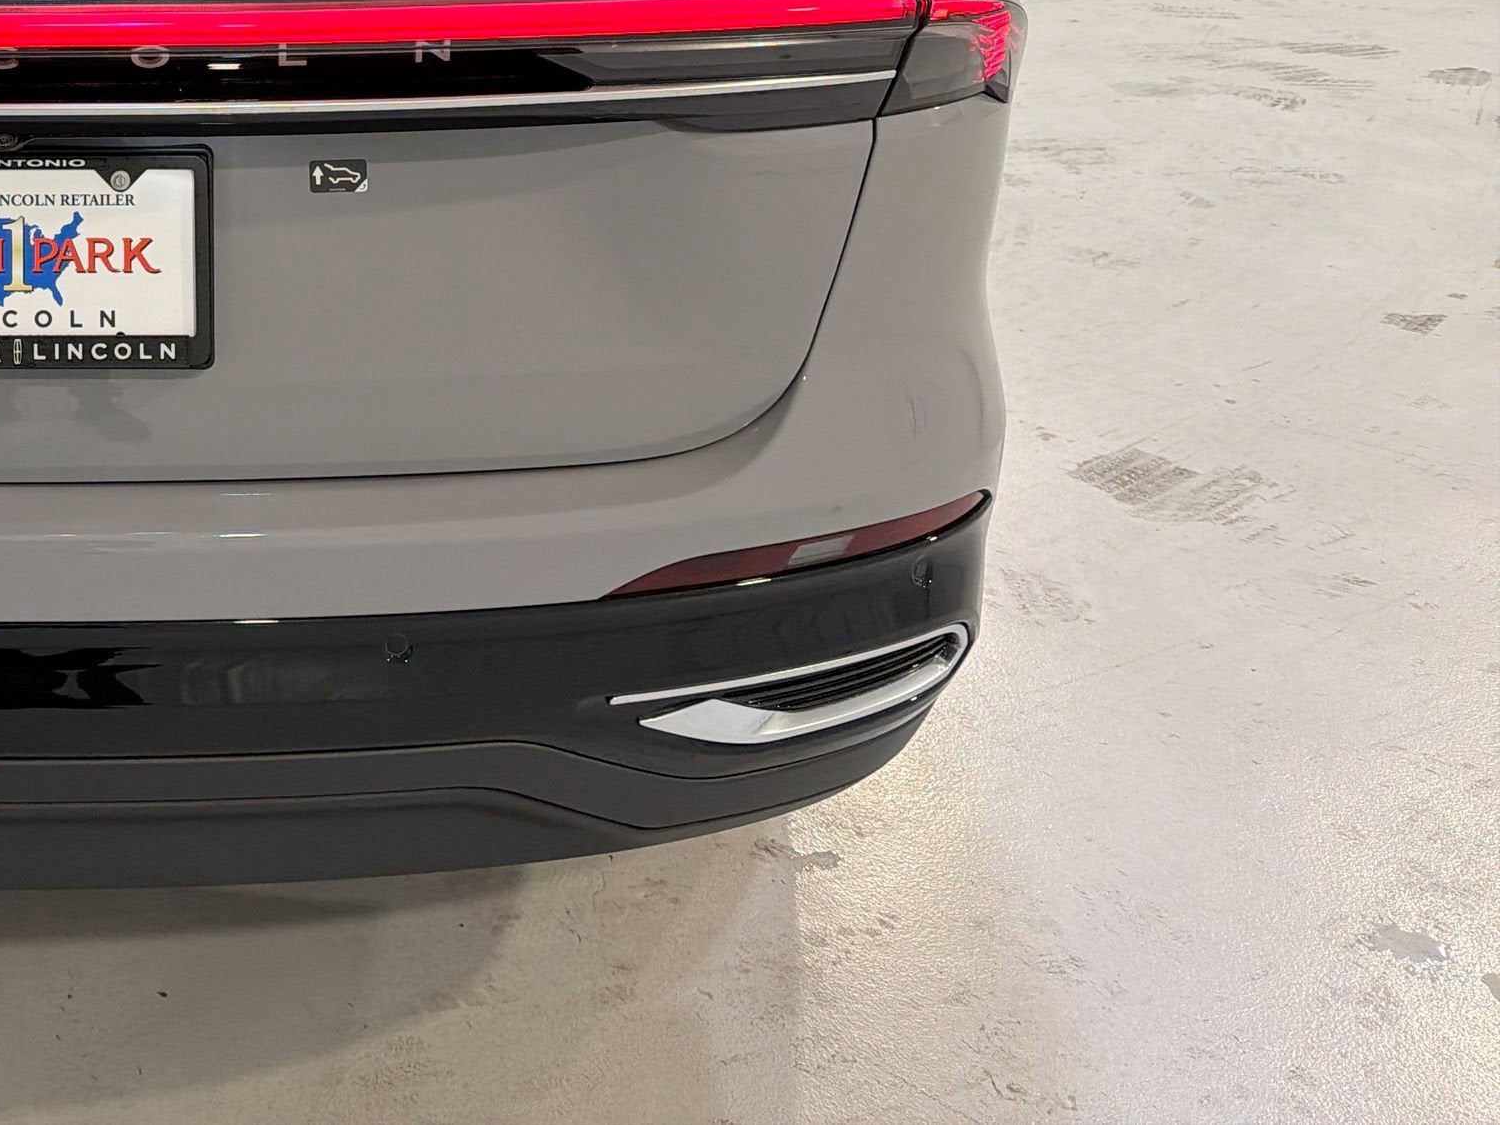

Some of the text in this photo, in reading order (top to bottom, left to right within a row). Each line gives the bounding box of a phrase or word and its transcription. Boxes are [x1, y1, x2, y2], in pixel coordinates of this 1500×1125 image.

[60, 194, 136, 207] RETAILER
[31, 236, 163, 274] PARK
[33, 342, 177, 361] LINCOLN
